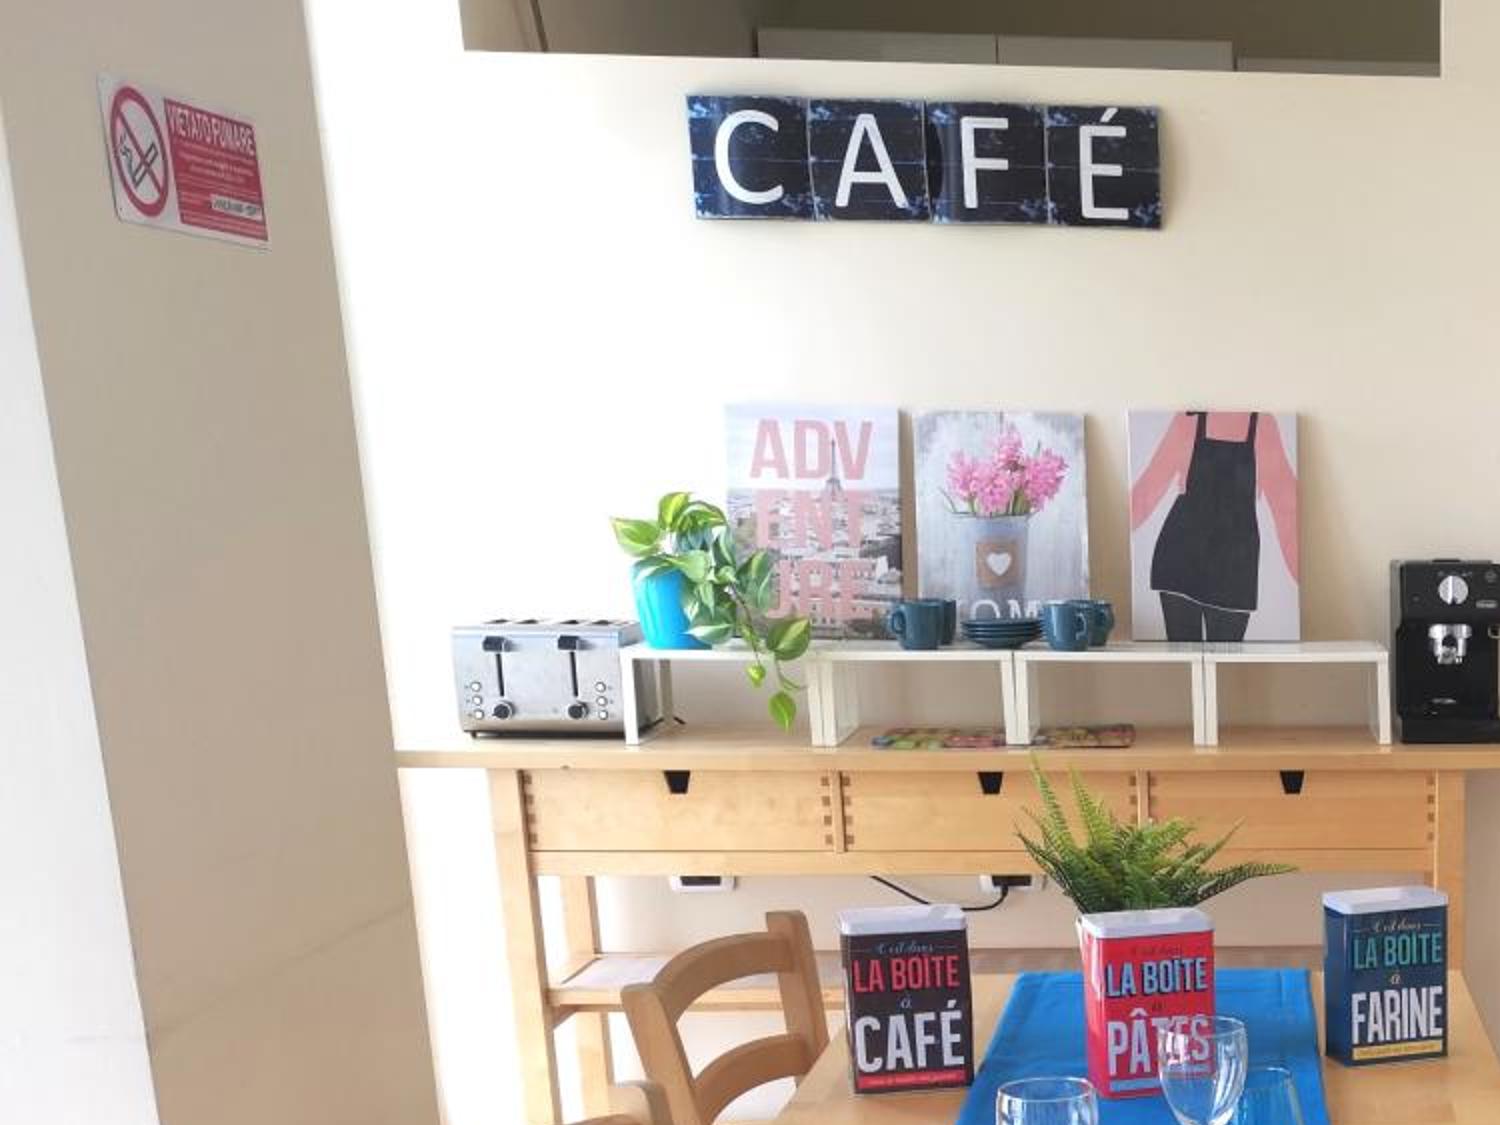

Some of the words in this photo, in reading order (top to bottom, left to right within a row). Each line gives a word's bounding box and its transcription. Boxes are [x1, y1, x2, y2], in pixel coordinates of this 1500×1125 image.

[167, 104, 211, 143] VIETATO
[714, 107, 1130, 220] CAFÉ
[750, 418, 873, 481] ADV
[755, 489, 878, 551] ENT
[853, 959, 884, 993] LA
[1107, 962, 1136, 997] LA
[1354, 937, 1378, 970] LA
[855, 999, 964, 1073] CAFÉ
[1107, 1008, 1209, 1077] PÂTES
[1351, 985, 1443, 1044] FARINE
